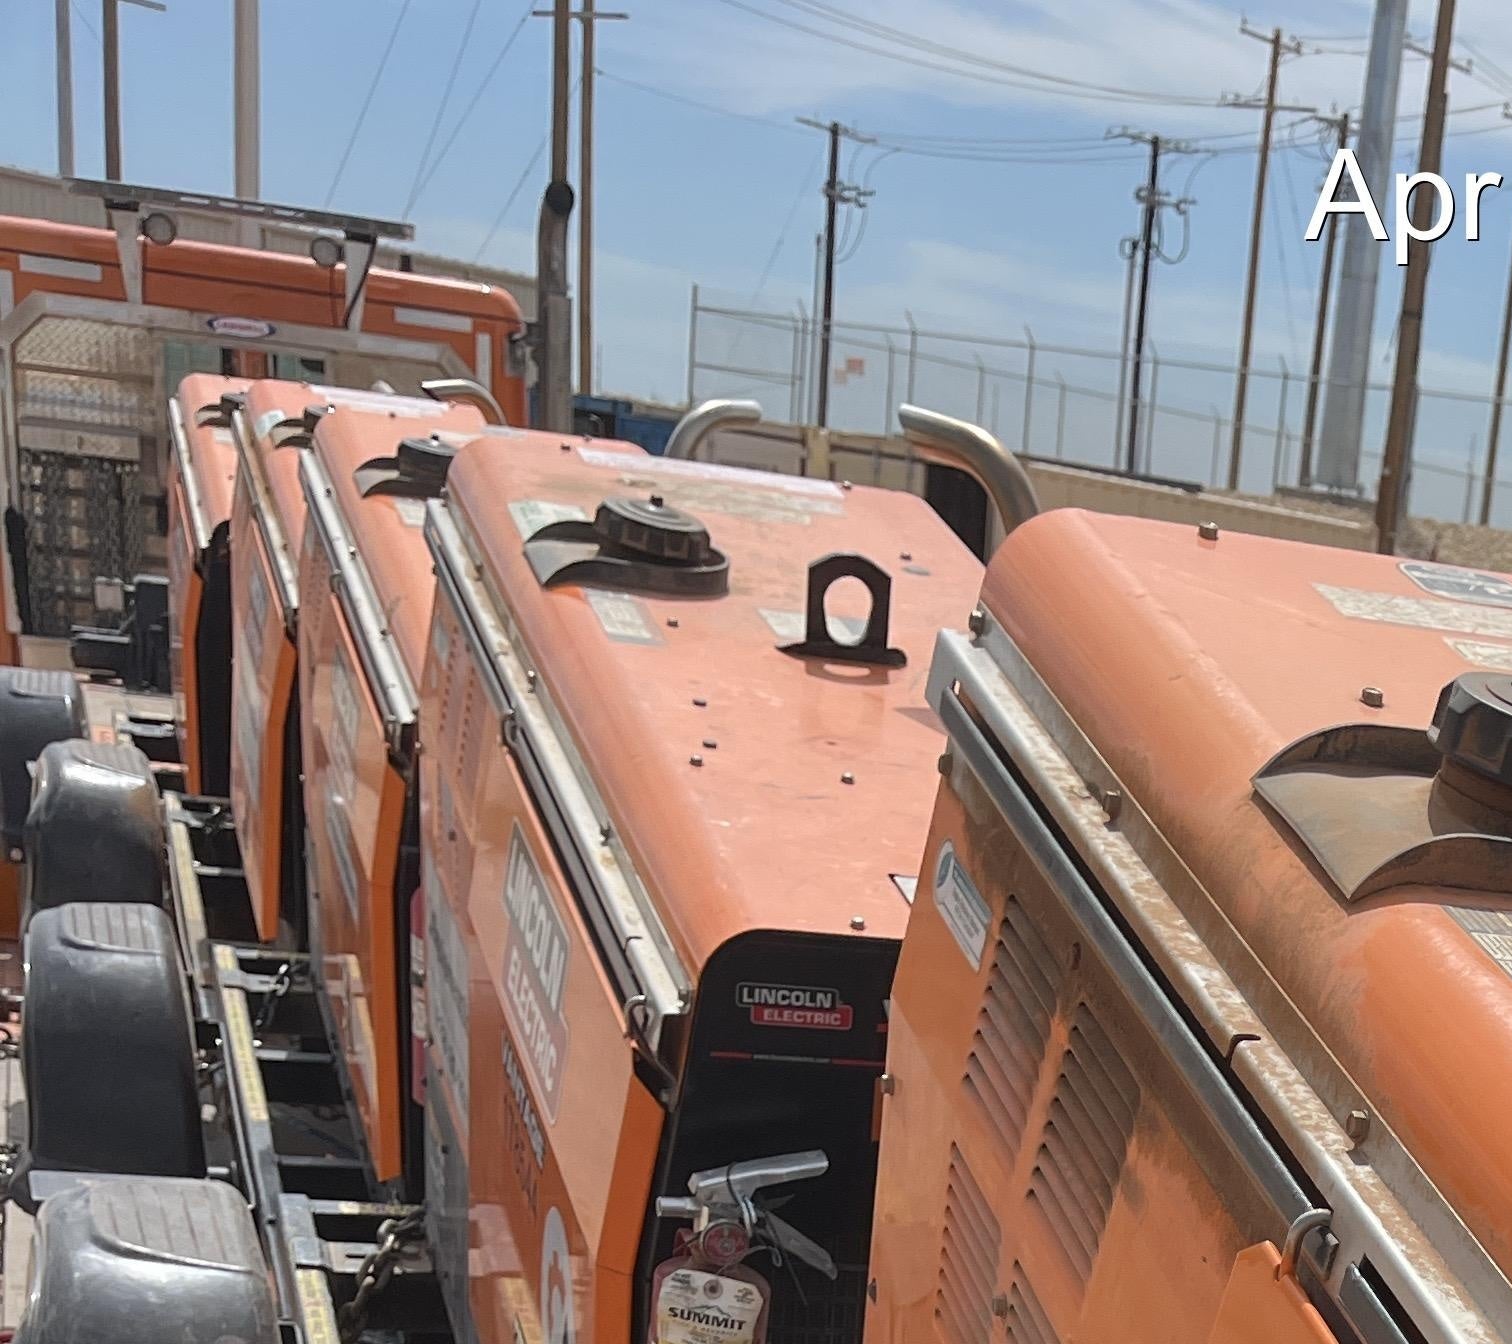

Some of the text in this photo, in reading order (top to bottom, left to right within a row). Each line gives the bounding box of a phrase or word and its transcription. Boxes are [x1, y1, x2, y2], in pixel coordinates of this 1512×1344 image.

[506, 843, 565, 1011] LINCOLN
[742, 986, 833, 1009] LINCOLN
[507, 945, 558, 1092] ELECTRIC
[763, 1008, 842, 1026] ELECTRIC
[667, 1306, 747, 1331] SUMMIT
